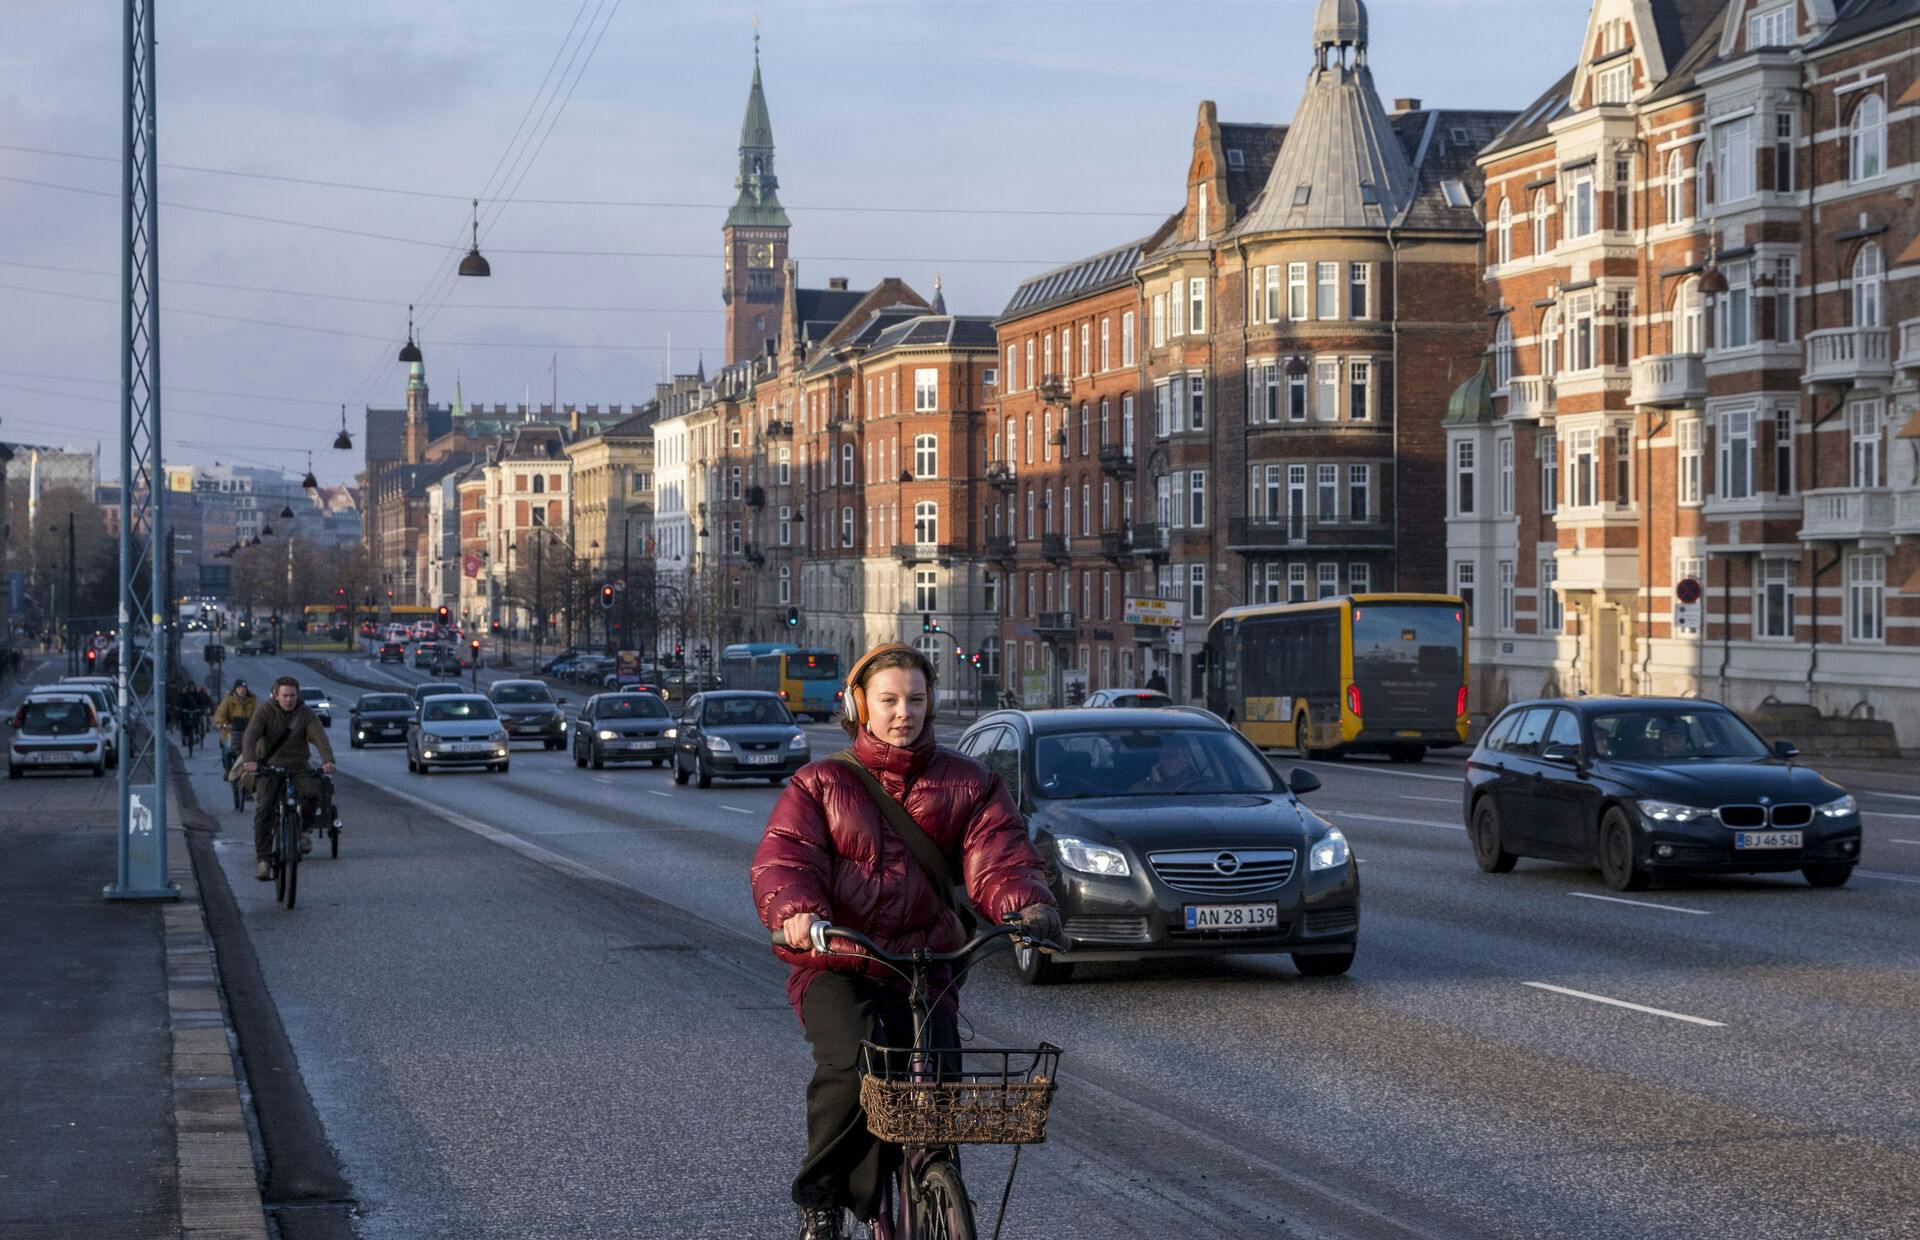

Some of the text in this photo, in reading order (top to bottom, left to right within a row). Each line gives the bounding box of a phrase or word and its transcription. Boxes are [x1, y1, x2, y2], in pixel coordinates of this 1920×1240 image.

[1745, 834, 1799, 846] BJ 46 541
[1198, 908, 1275, 925] AN 28 139
